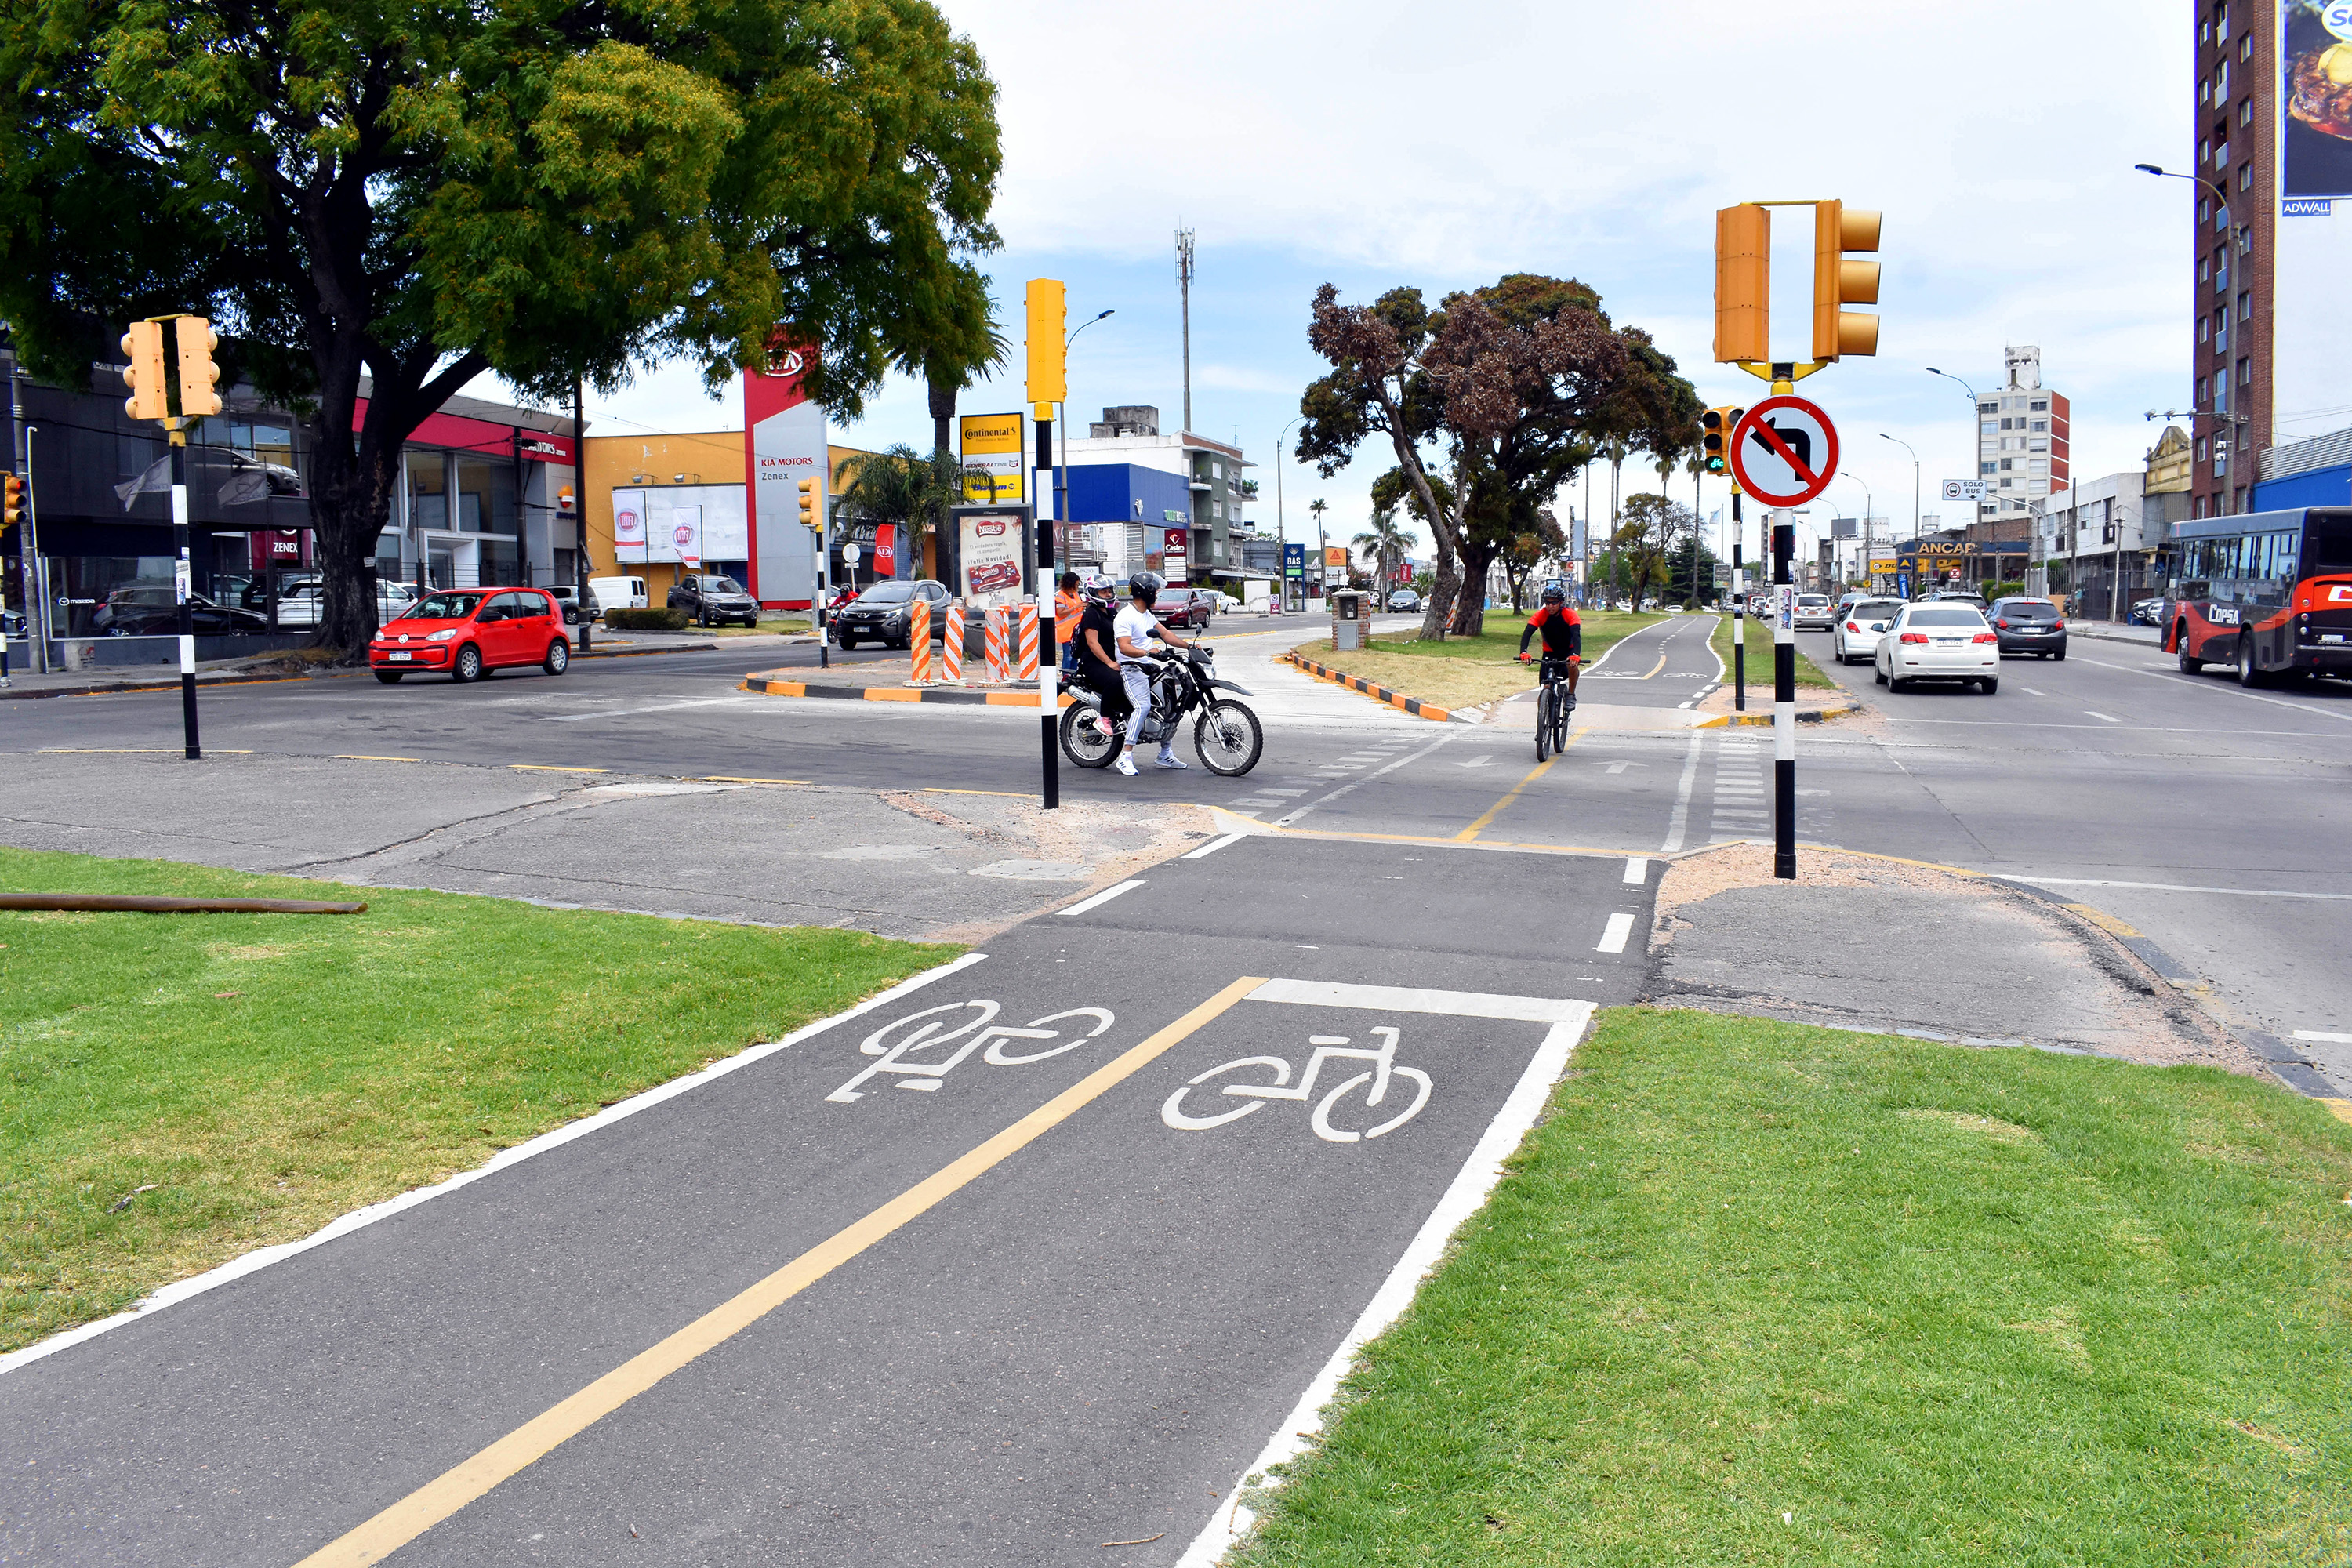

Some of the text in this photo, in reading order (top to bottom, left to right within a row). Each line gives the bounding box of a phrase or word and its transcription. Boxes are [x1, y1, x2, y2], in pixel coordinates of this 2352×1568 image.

[2329, 9, 2352, 26] S
[2283, 201, 2330, 213] ADWALL
[965, 428, 1009, 440] Continental
[778, 457, 813, 466] MOTORS
[762, 472, 789, 481] Zenex
[273, 542, 298, 553] ZENEX
[1919, 543, 1976, 554] ANCAP
